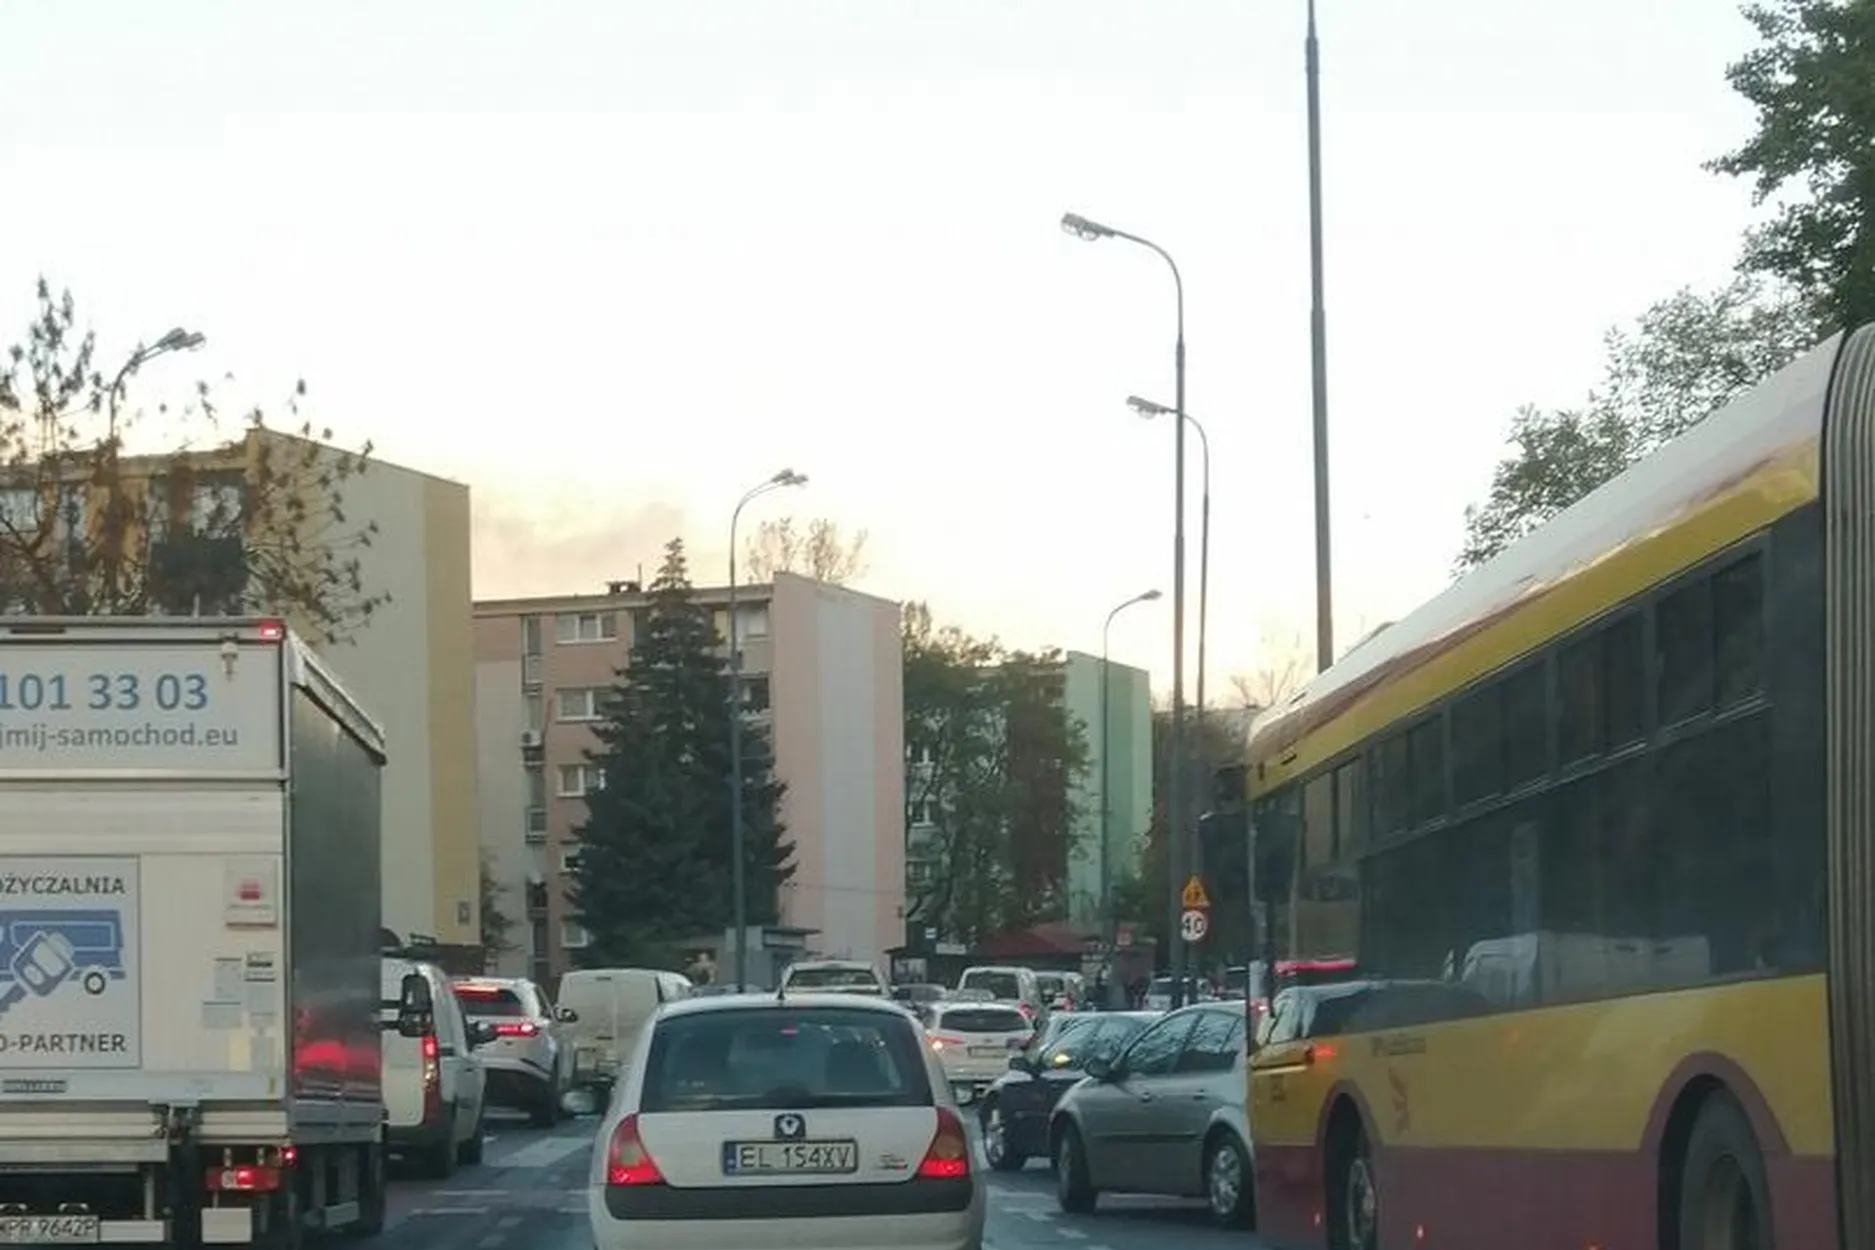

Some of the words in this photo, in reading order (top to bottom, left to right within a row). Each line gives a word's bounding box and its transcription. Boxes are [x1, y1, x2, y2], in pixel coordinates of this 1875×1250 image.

[0, 673, 71, 710] 101
[87, 673, 141, 710] 33
[155, 673, 208, 710] 03
[0, 870, 125, 894] ŻYCZALNIA
[1183, 917, 1204, 934] 40
[740, 1147, 771, 1169] EL
[783, 1146, 850, 1169] 154XV
